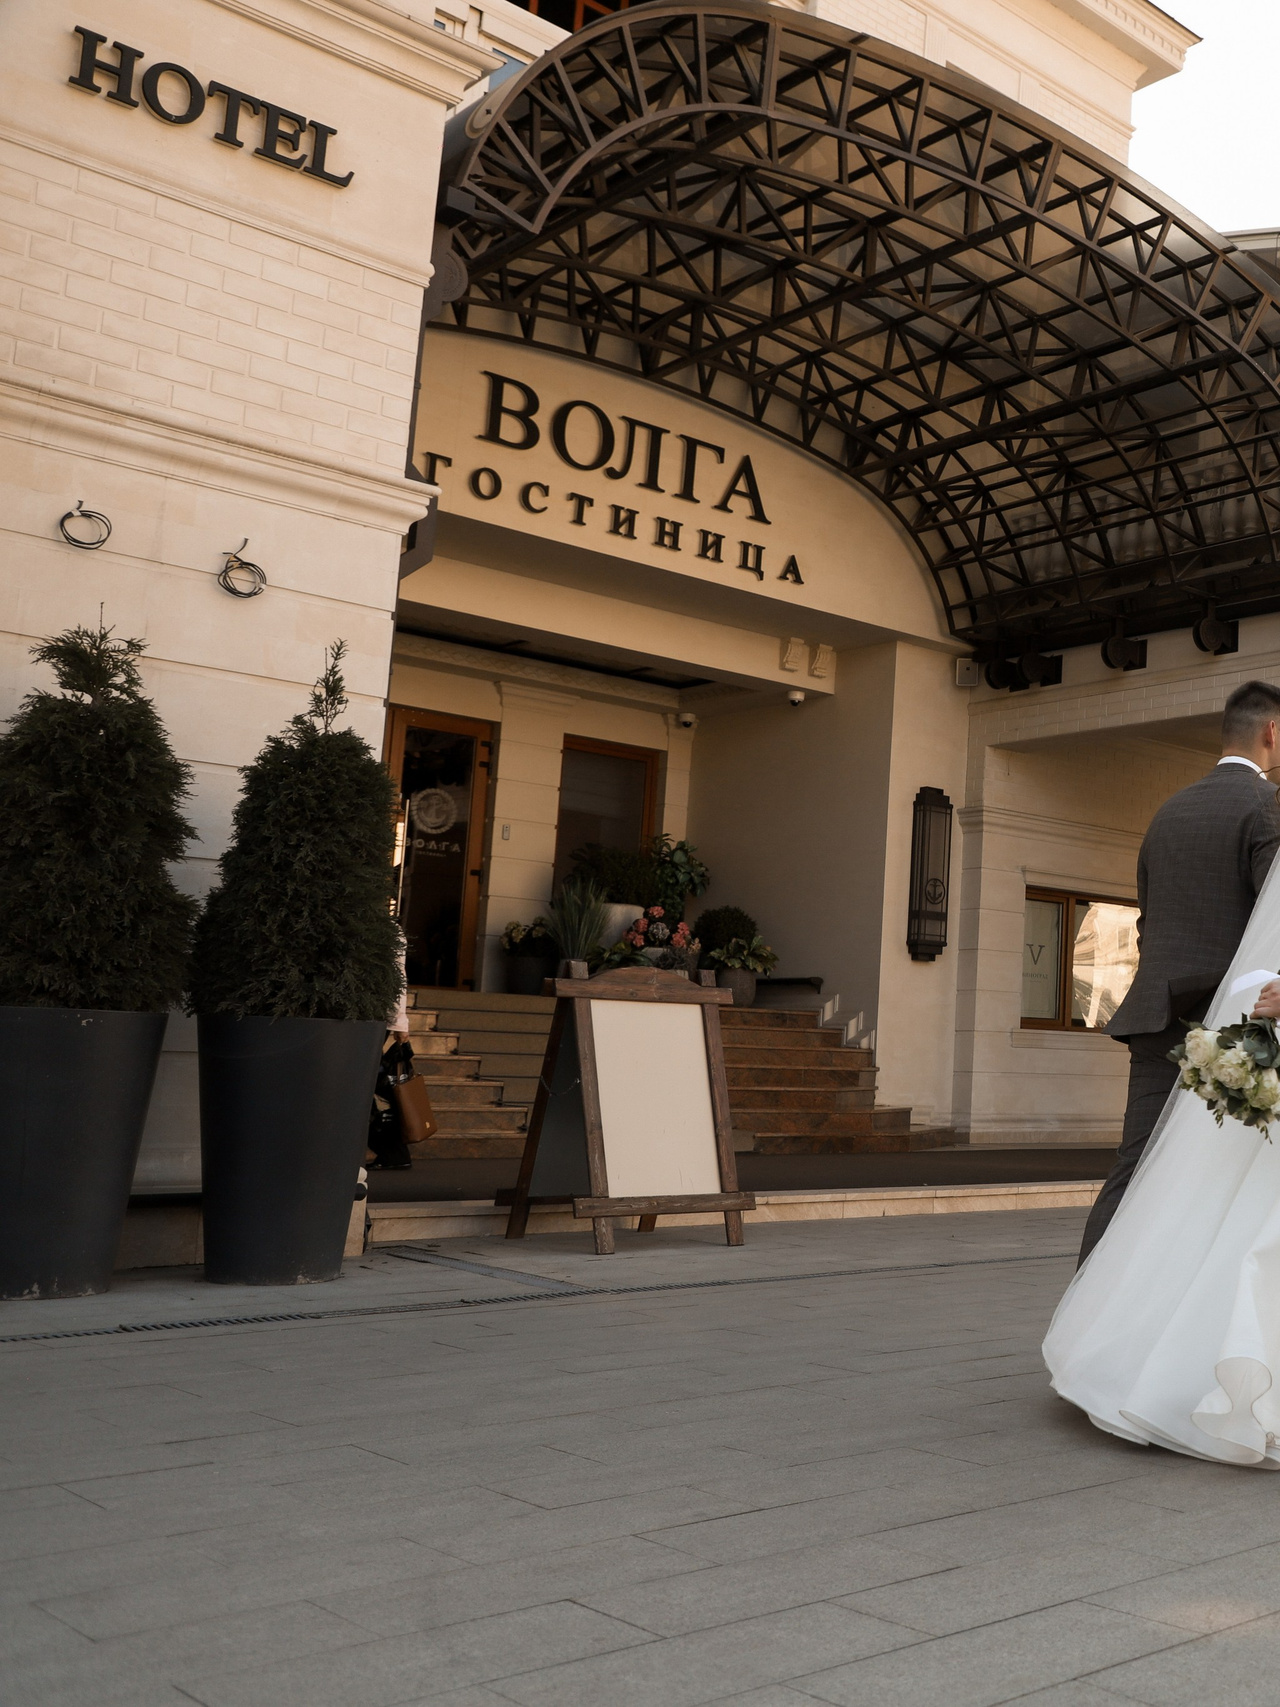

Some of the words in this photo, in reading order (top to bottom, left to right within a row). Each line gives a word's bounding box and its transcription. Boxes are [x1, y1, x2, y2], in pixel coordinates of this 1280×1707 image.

[68, 25, 355, 188] HOTEL
[424, 450, 805, 585] ГОСТИНИЦА
[475, 370, 772, 526] ВОЛГА
[1026, 943, 1046, 966] V
